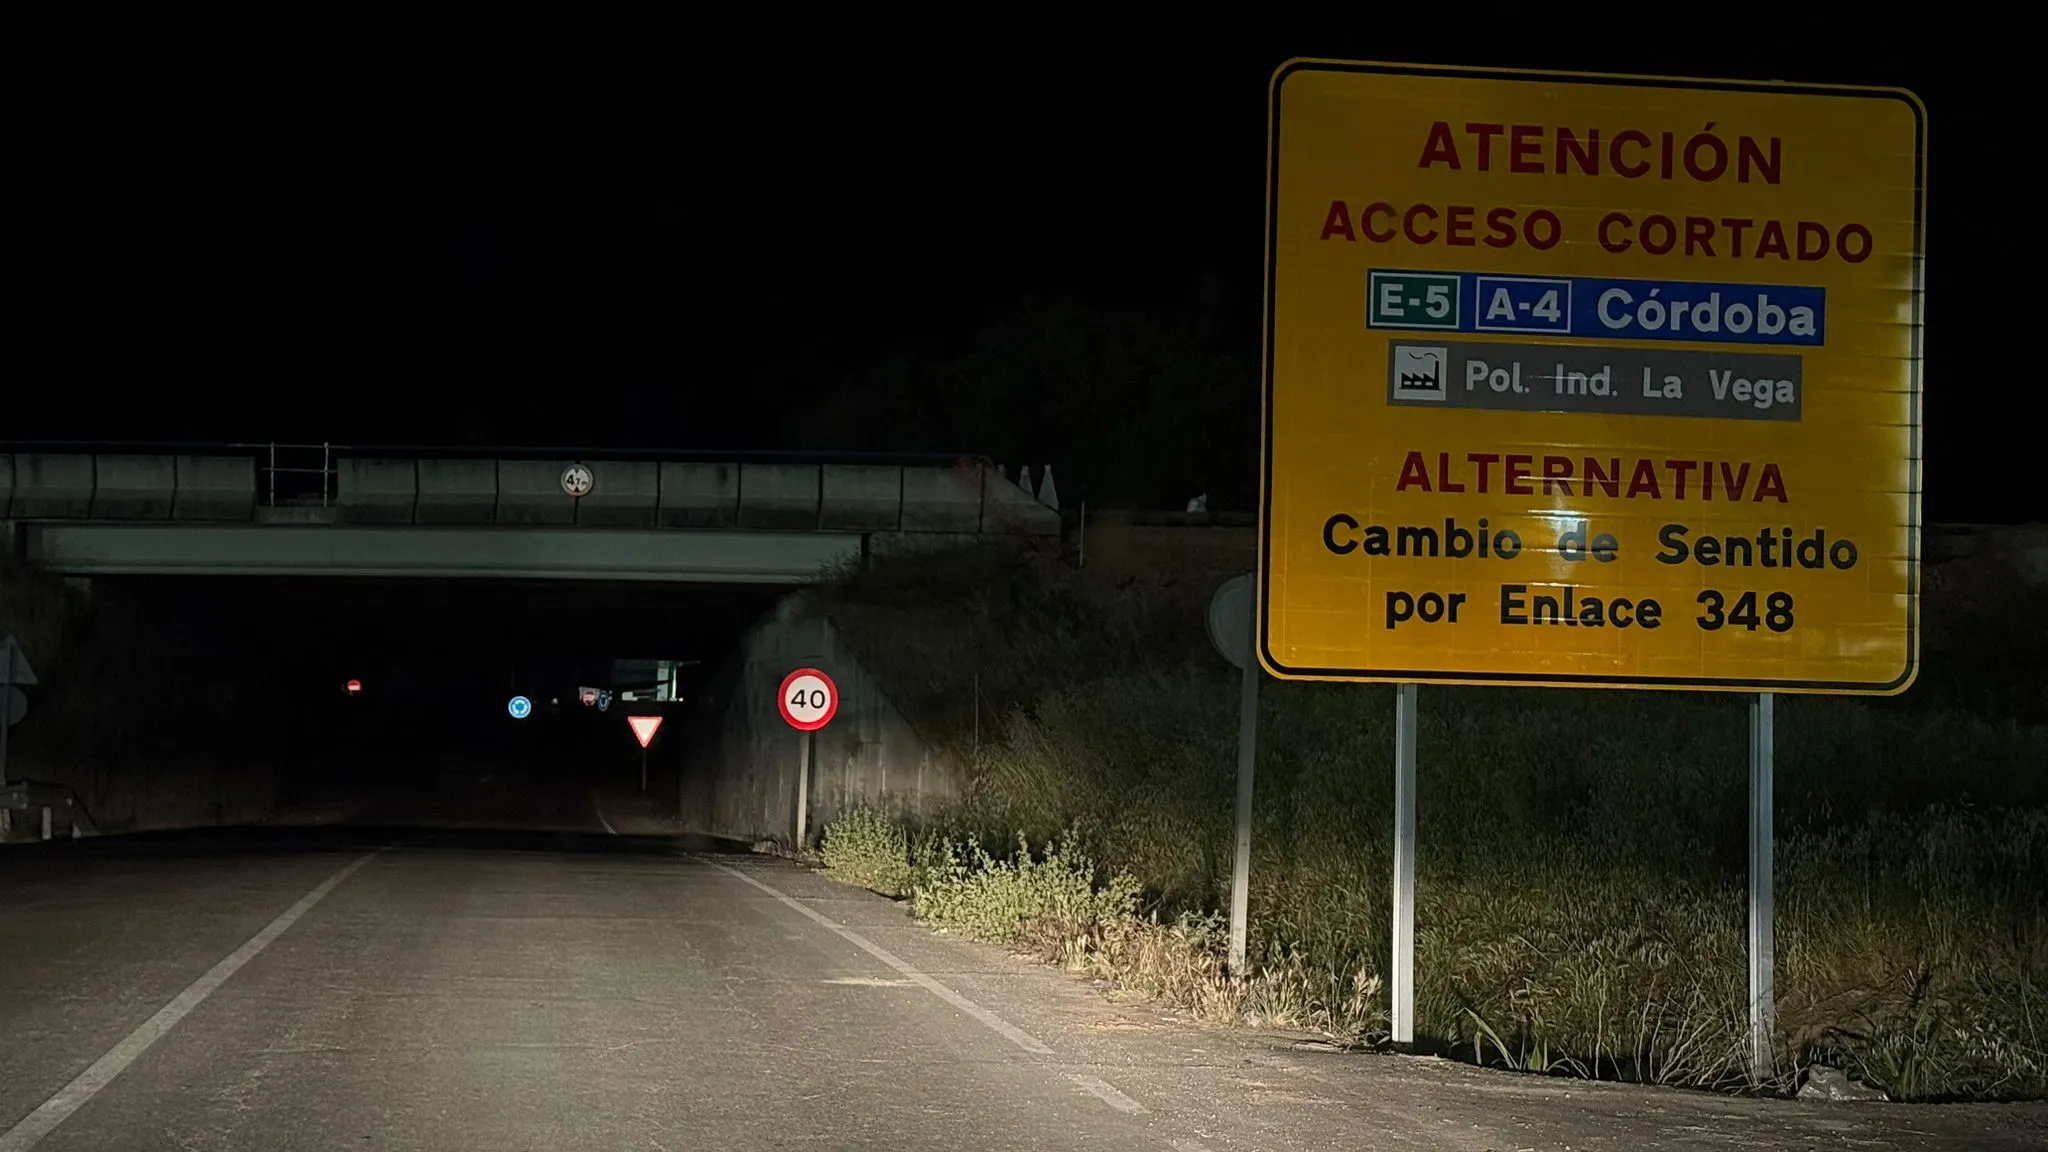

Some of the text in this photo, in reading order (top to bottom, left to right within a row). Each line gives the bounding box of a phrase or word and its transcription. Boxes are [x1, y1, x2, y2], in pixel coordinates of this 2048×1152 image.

[1418, 121, 1782, 184] ATENCIÓN
[1320, 200, 1874, 263] ACCESO CORTADO
[1379, 282, 1816, 336] E-5 A-4 Córdoba
[1465, 360, 1795, 409] Pol. Ind. La Vega
[1396, 451, 1789, 503] ALTERNATIVA
[1322, 513, 1859, 570] Cambio de Sentido
[1385, 584, 1795, 633] por Enlace 348
[791, 689, 825, 709] 40
